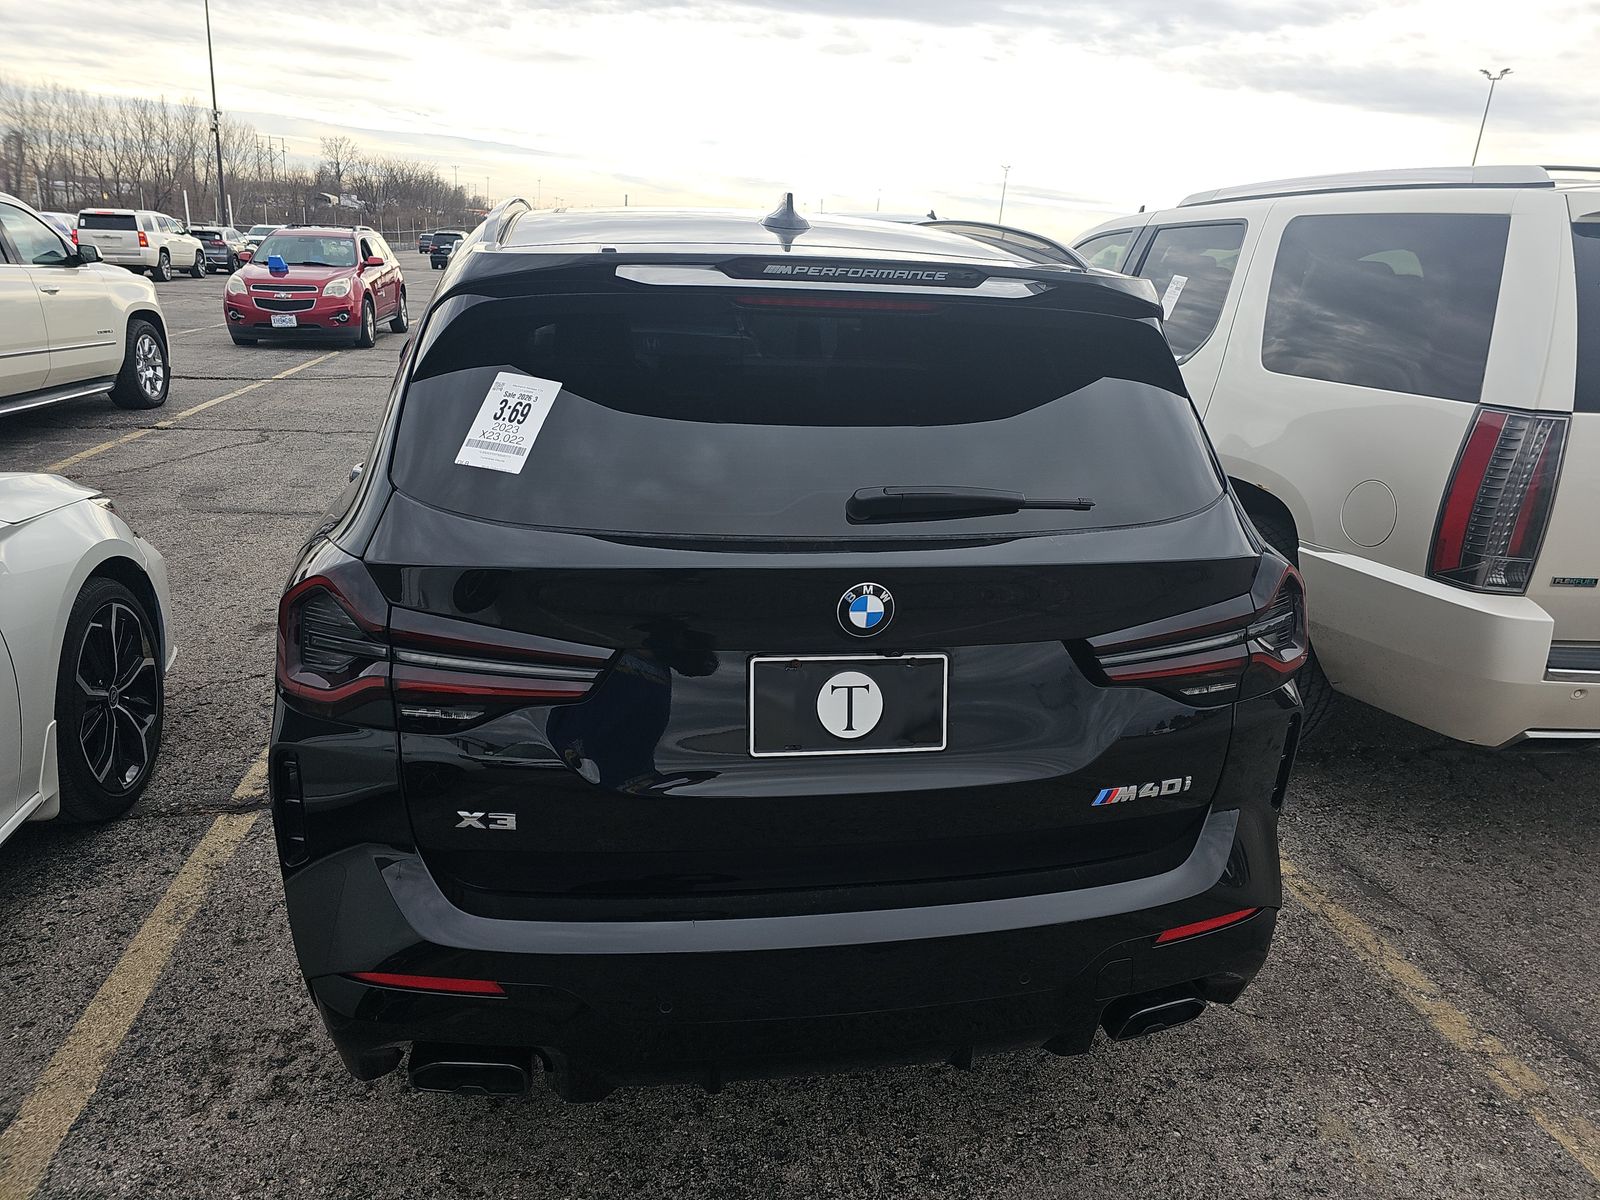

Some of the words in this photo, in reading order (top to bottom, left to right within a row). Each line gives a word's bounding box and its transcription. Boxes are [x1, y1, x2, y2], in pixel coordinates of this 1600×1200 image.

[503, 390, 517, 399] Sale
[492, 421, 520, 434] 2023
[844, 584, 891, 604] BMW
[831, 683, 870, 732] T
[455, 810, 517, 831] X3
